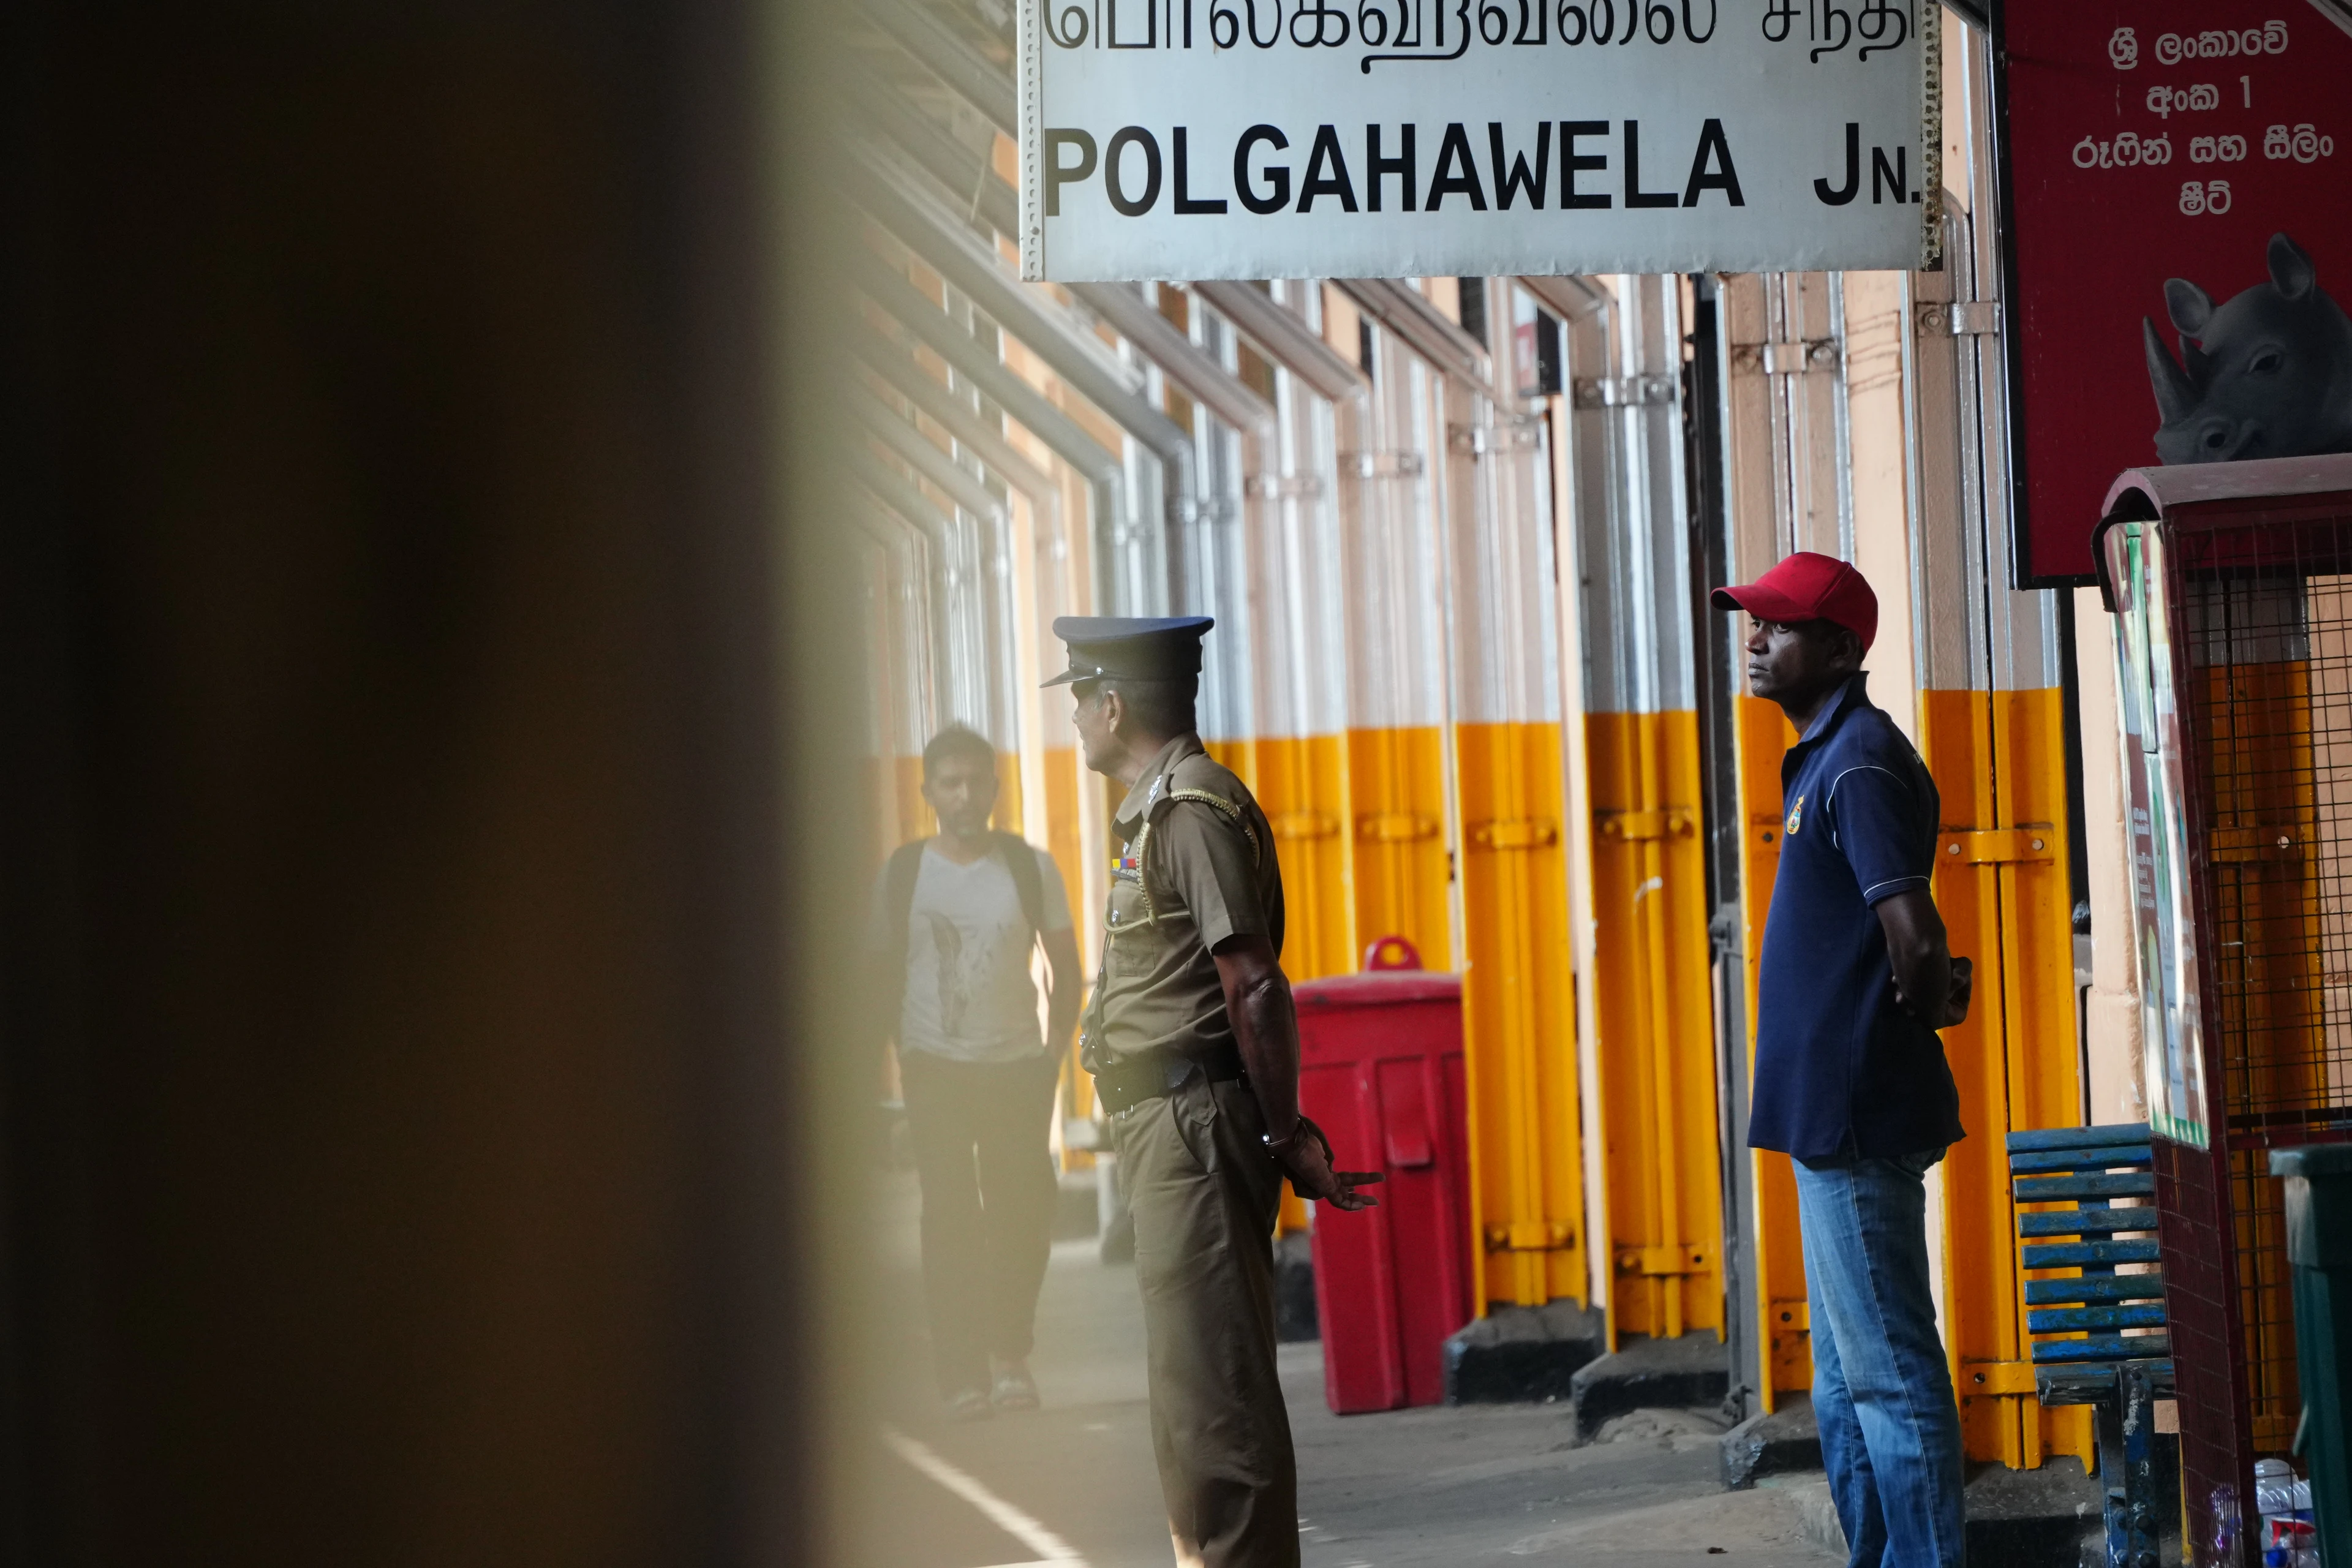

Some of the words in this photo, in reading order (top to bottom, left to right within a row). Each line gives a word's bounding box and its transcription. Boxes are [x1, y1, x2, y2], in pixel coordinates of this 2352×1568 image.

[2155, 20, 2288, 64] ලංකාවේ
[2147, 85, 2218, 119] අංක
[2240, 76, 2251, 108] 1
[2190, 135, 2247, 163] සහ
[2264, 124, 2333, 163] සීලිං
[1044, 118, 1745, 216] POLGAHAWELA
[2179, 181, 2231, 216] ෂීට්
